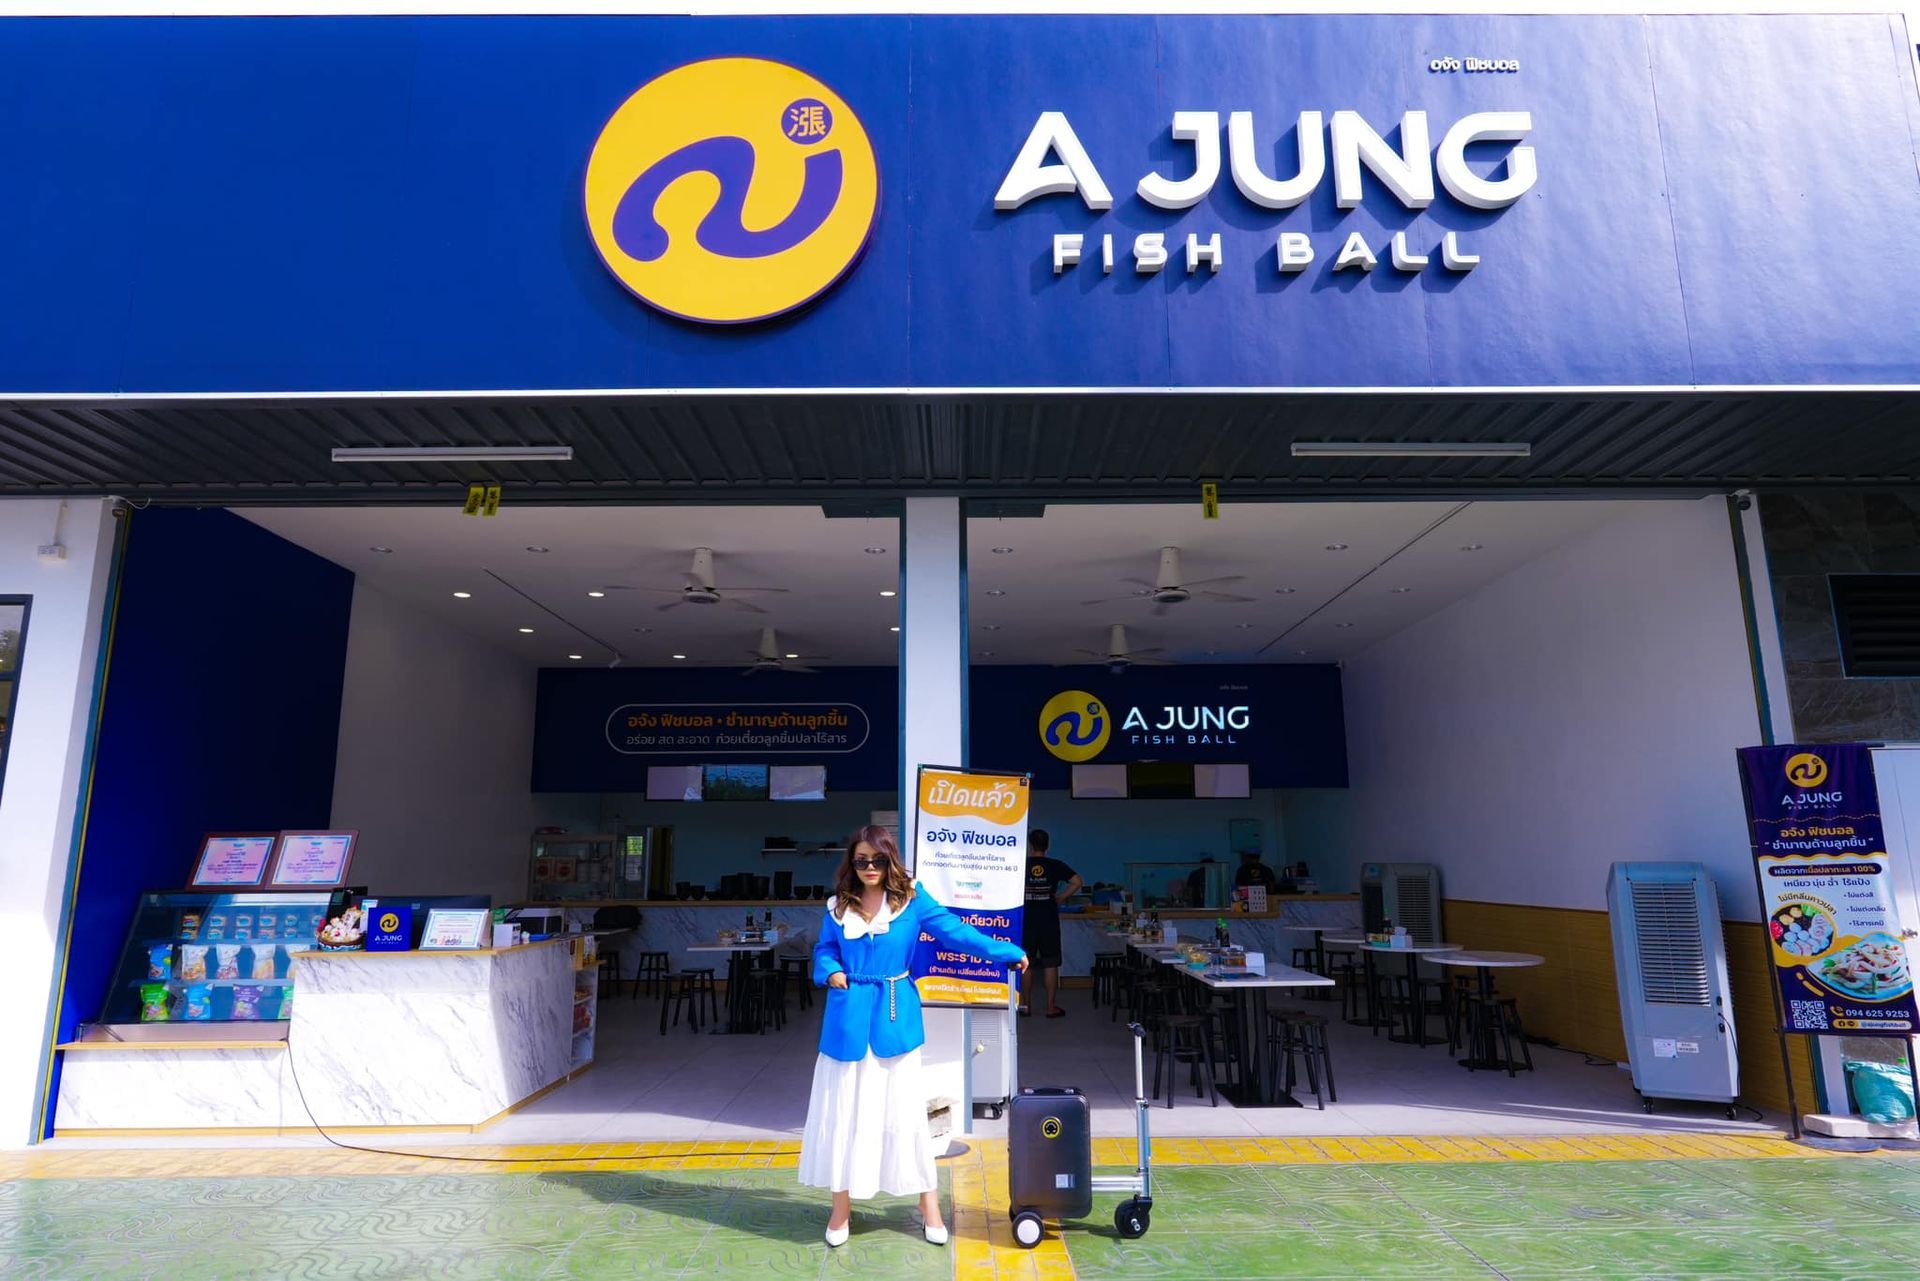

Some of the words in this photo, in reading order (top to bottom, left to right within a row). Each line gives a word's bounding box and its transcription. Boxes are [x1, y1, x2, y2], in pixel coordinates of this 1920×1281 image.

[1429, 56, 1460, 72] อจัง
[1465, 57, 1520, 72] ฟิชบอล
[995, 112, 1113, 210] A
[1137, 111, 1538, 210] JUNG
[1053, 233, 1222, 272] FISH
[1278, 232, 1480, 272] BALL
[628, 712, 657, 727] อจัง
[661, 713, 713, 727] ฟิชบอล
[1122, 706, 1149, 730] A
[1156, 706, 1249, 730] JUNG
[658, 735, 674, 745] สด
[677, 735, 710, 745] สะอาด
[1132, 735, 1175, 744] FISH
[1188, 735, 1237, 744] BALL
[927, 779, 1017, 809] เปิดแล้ว
[1782, 795, 1795, 805] A
[1797, 791, 1843, 804] JUNG
[927, 828, 957, 843] อจัง
[962, 830, 1017, 847] ฟิชบอล
[1780, 827, 1806, 838] อจัง
[1808, 826, 1855, 836] ฟิชบอล
[1845, 1009, 1863, 1017] 094
[1885, 1010, 1910, 1018] 9253
